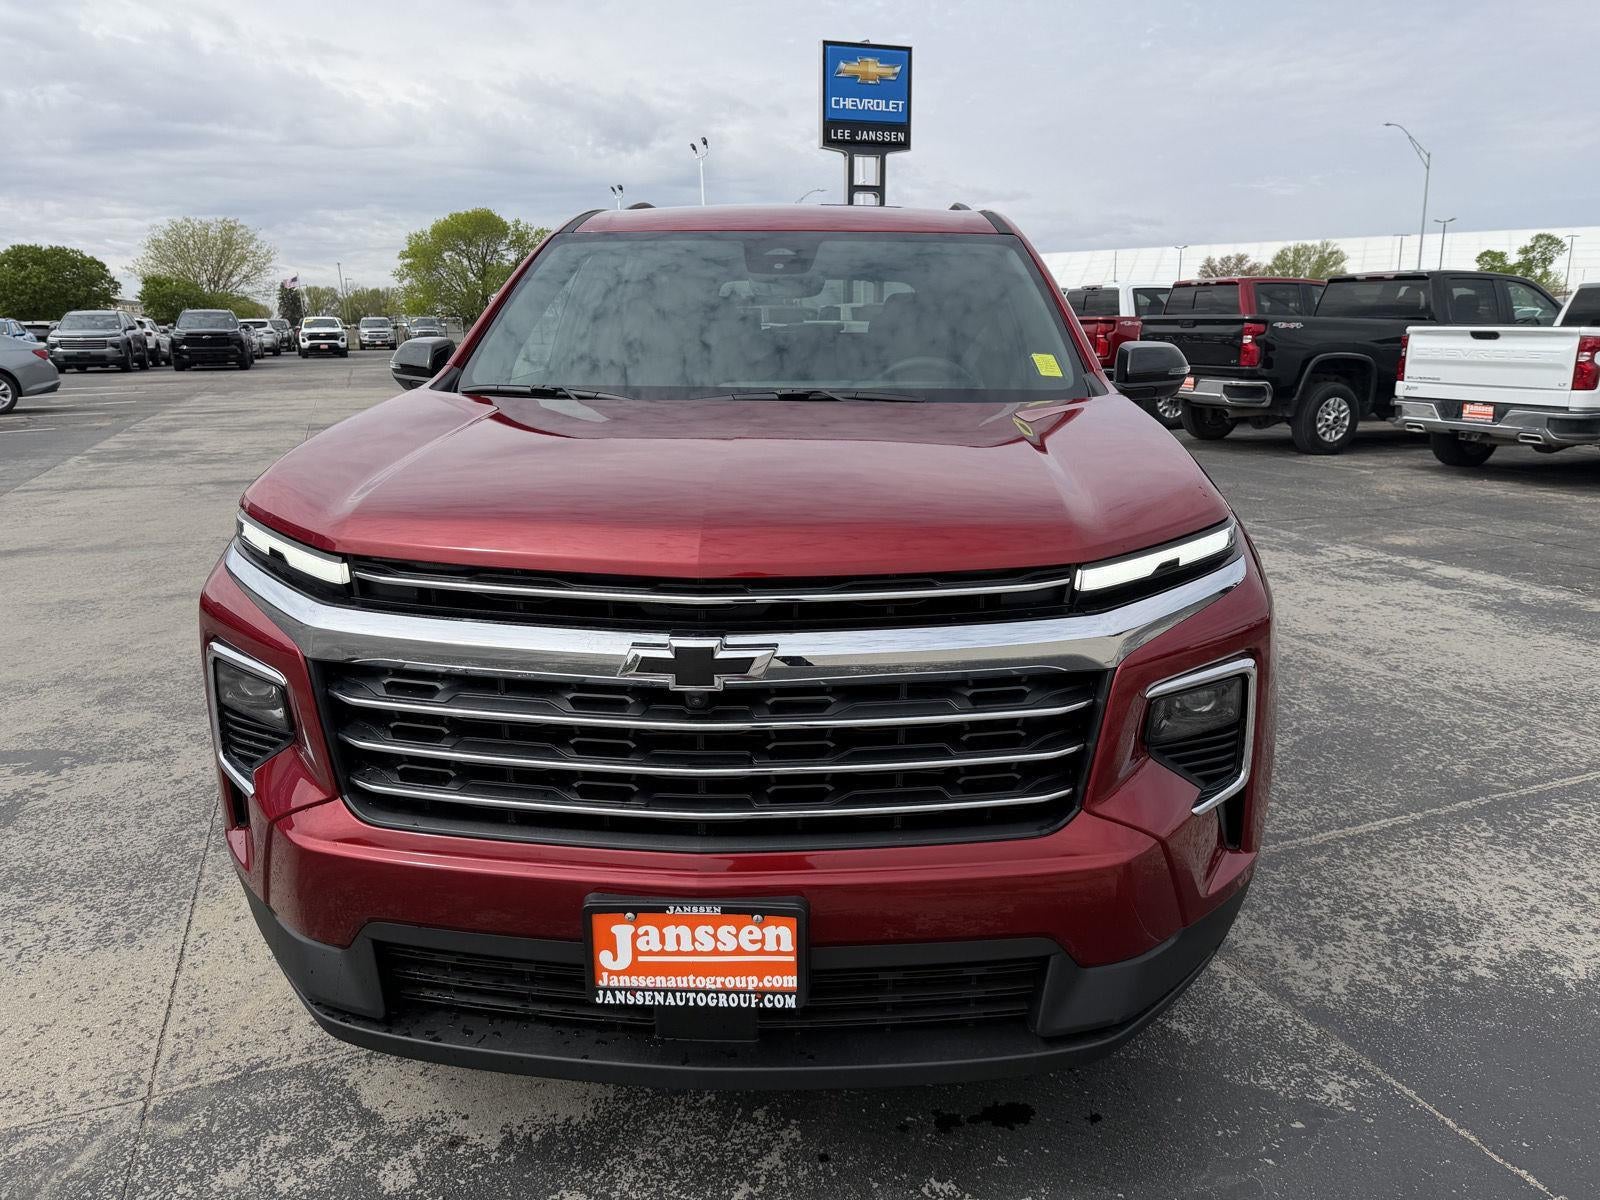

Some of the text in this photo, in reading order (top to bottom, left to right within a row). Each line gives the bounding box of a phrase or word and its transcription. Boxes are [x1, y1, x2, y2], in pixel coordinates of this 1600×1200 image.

[831, 97, 905, 113] CHEVROLET
[831, 129, 905, 142] LEE JANSSEN
[666, 905, 722, 915] JANSSEN
[598, 924, 795, 971] Janssen
[598, 972, 797, 990] Janssenautogroup.com
